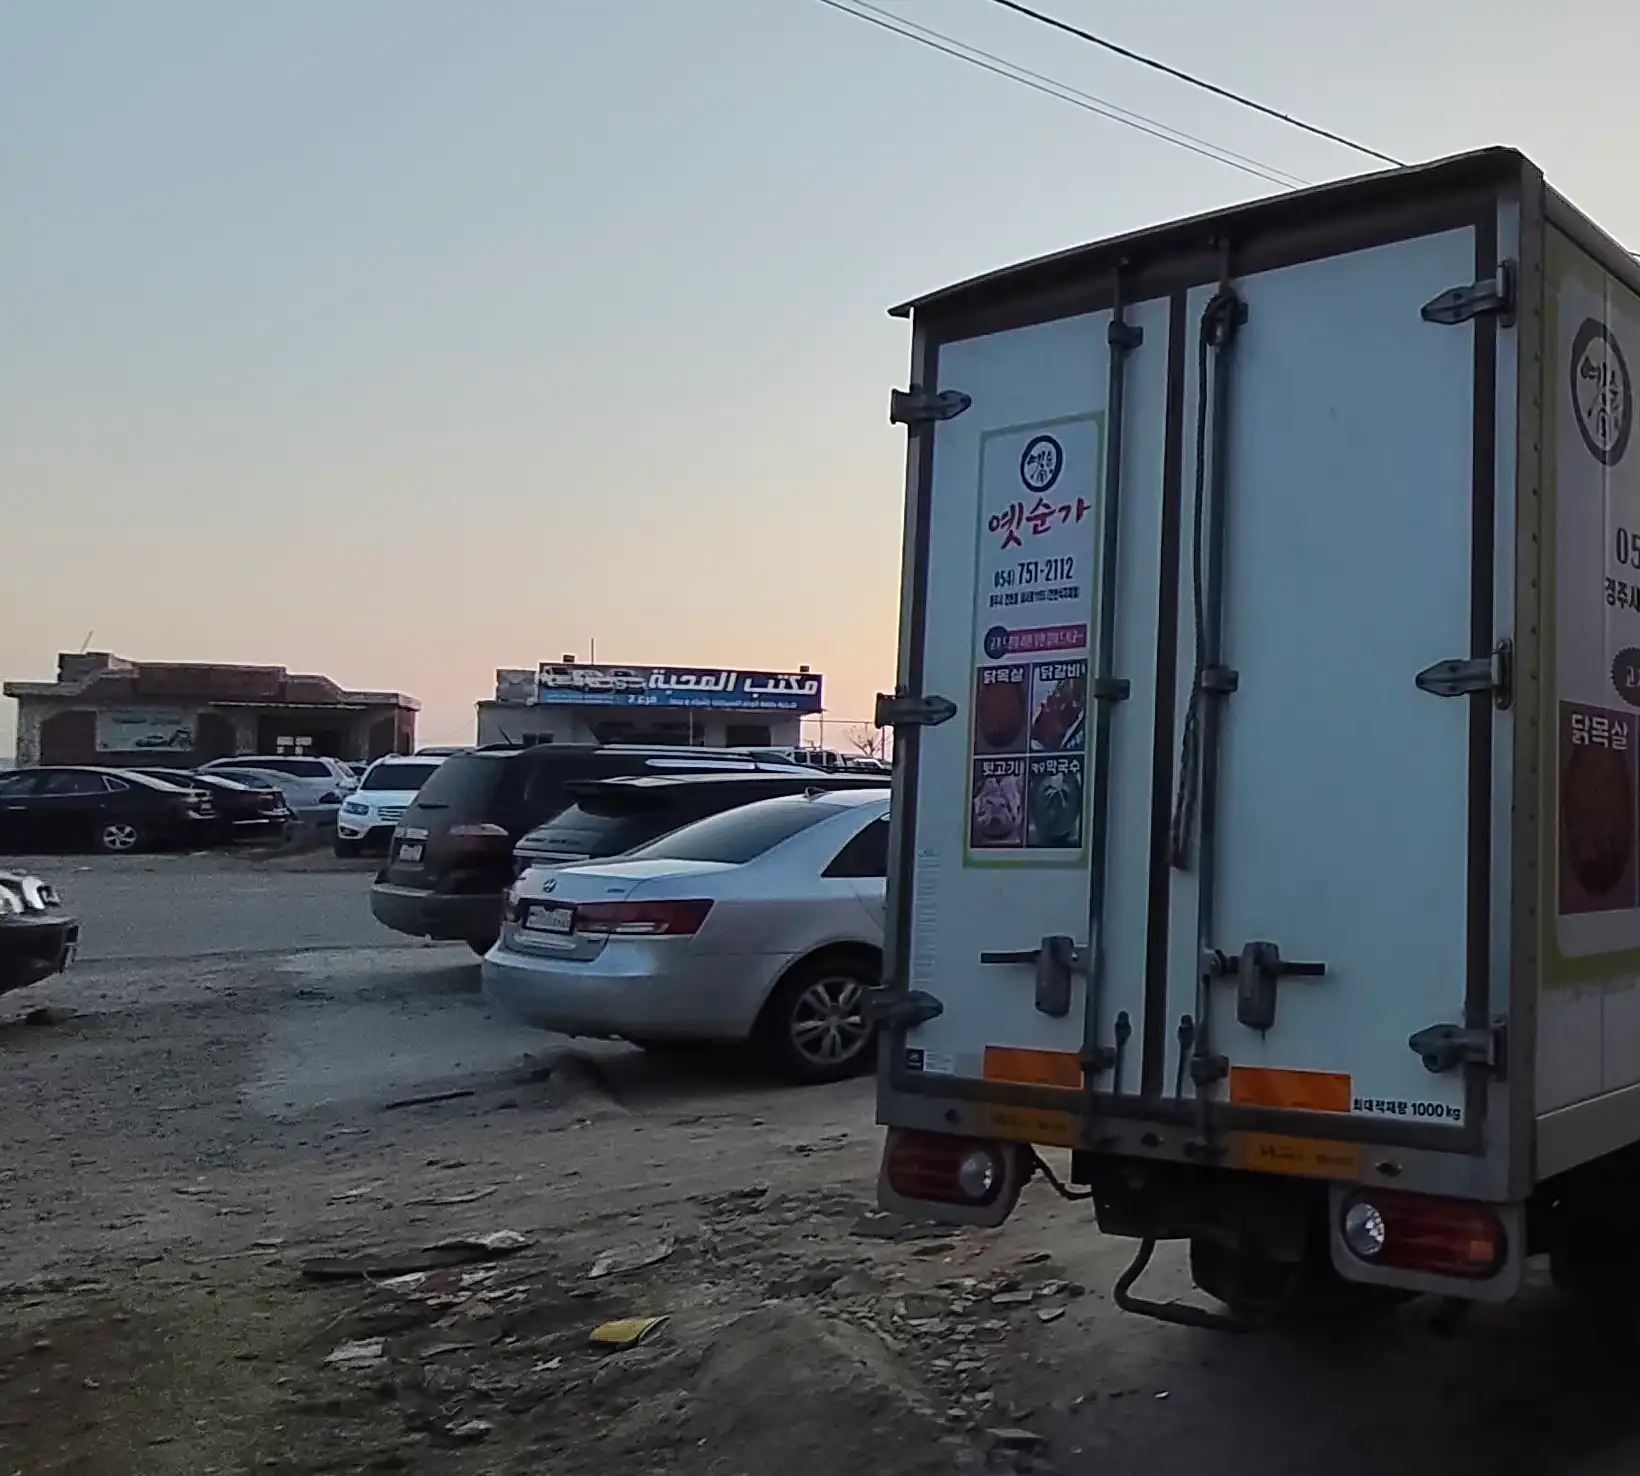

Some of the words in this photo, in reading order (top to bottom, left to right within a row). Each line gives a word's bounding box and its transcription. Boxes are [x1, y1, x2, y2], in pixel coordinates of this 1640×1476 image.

[988, 497, 1092, 550] 옛순가
[994, 569, 1015, 587] 054)
[1018, 556, 1074, 585] 751-2112
[1604, 577, 1640, 613] 경주시
[648, 669, 738, 694] المحبة
[983, 667, 1024, 684] 닭목살
[1041, 663, 1080, 680] 닭갈비
[744, 675, 819, 698] مكتب
[1571, 714, 1628, 750] 닭목살
